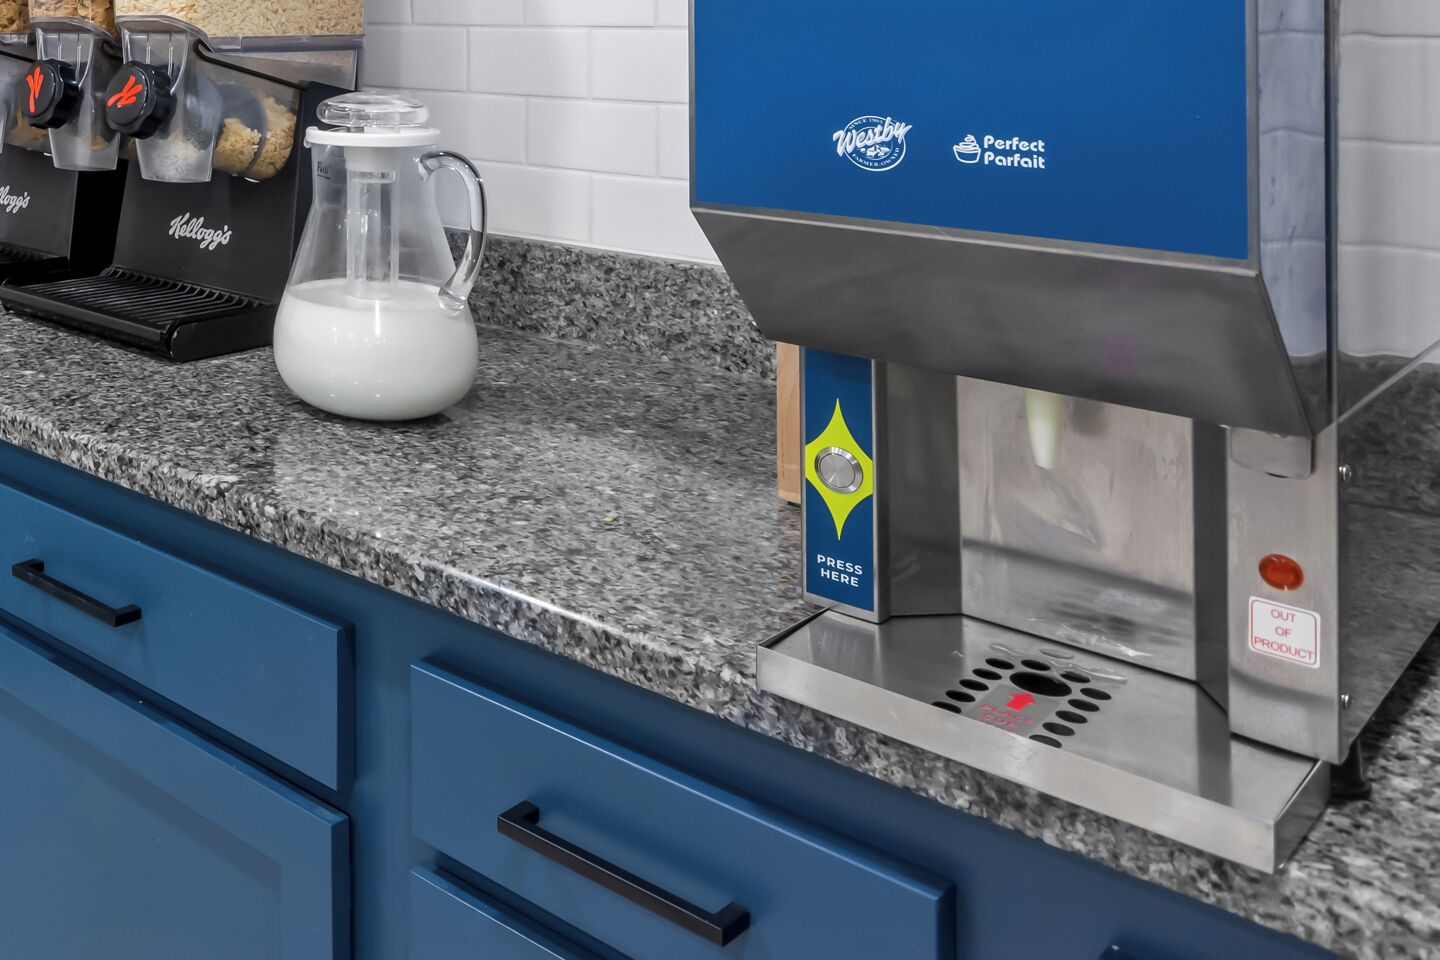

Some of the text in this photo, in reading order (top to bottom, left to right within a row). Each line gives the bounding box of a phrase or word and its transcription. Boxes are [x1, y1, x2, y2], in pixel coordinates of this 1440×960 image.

[832, 116, 913, 158] Westby
[983, 134, 1045, 152] Perfect
[984, 151, 1045, 169] Parfait
[168, 212, 233, 251] Kellogg's
[817, 554, 863, 575] PRESS
[820, 567, 859, 588] HERE
[1271, 608, 1296, 623] OUT
[1275, 626, 1292, 637] OF
[1254, 636, 1314, 661] PRODUCT
